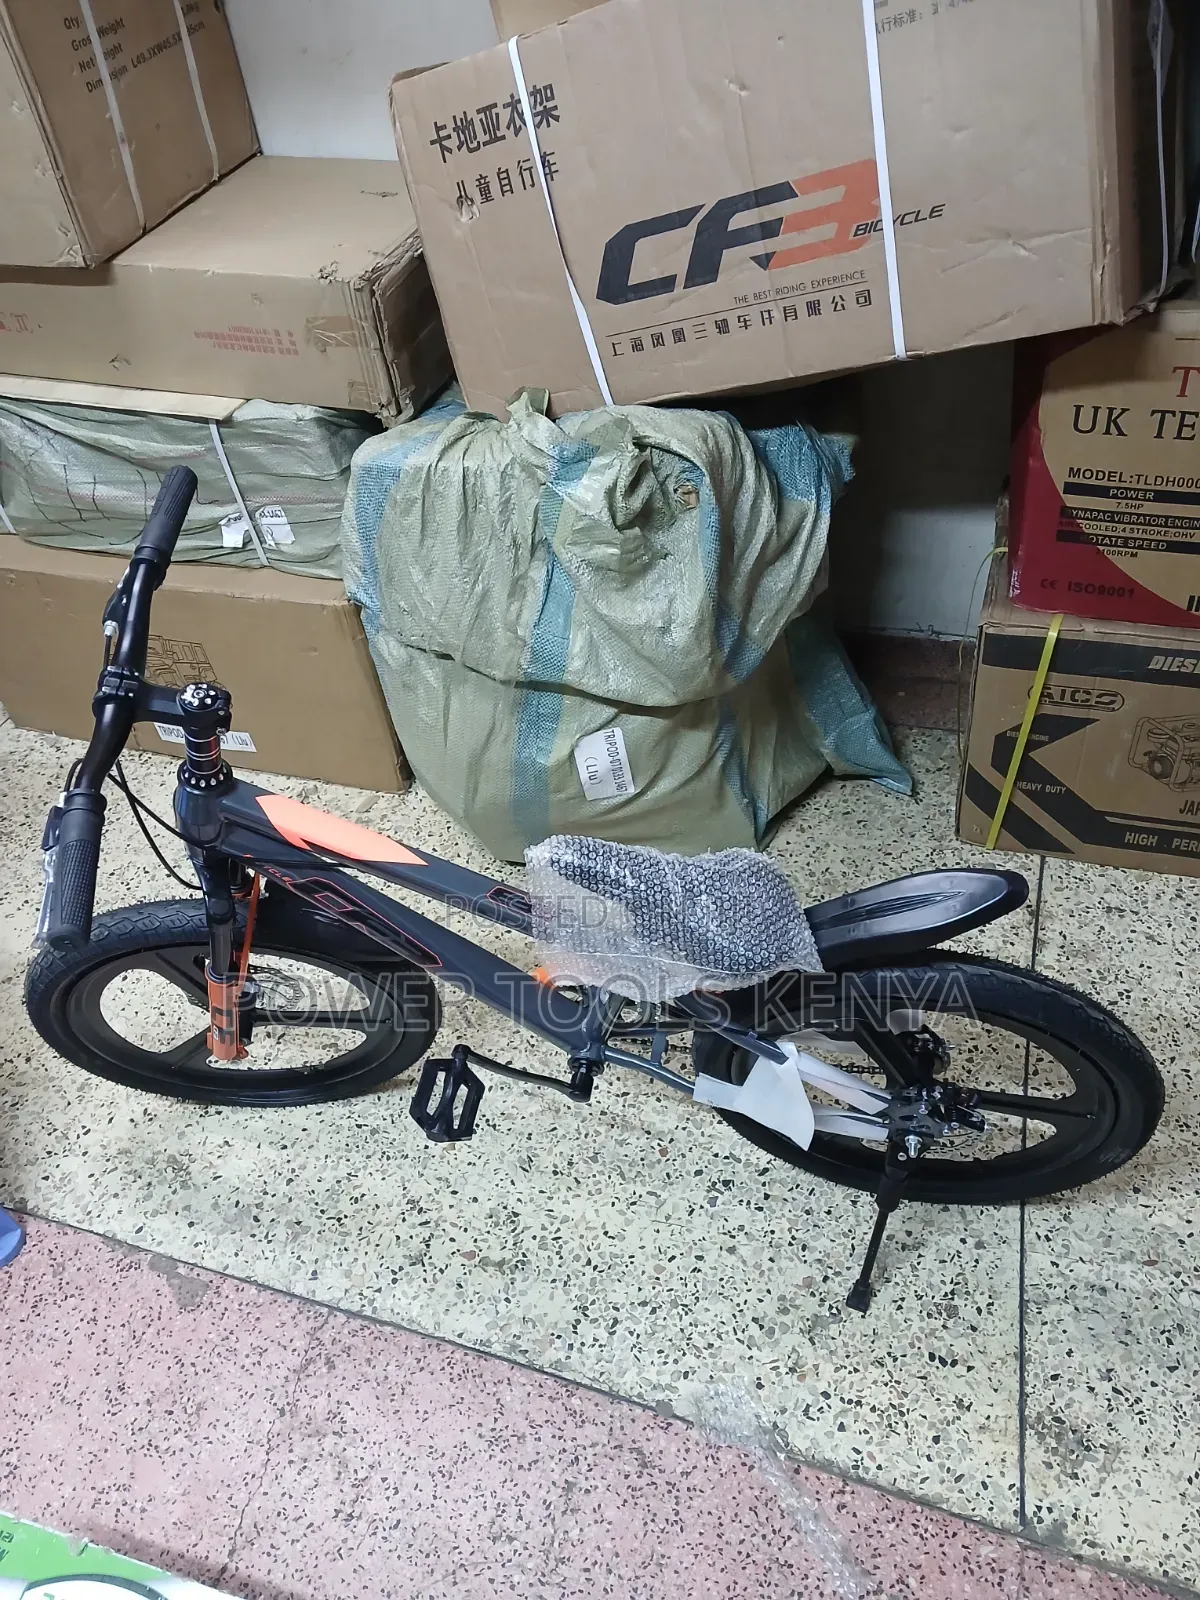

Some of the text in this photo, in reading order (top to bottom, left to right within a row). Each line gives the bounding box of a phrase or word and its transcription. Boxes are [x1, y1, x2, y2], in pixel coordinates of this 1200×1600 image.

[71, 35, 92, 51] Gros
[78, 42, 123, 73] Net eight
[429, 83, 560, 163] 卡地亚衣架
[456, 151, 559, 206] 儿童自行车
[734, 269, 866, 305] THE BEST RIDING EXPERIENCE
[1072, 404, 1199, 440] UK TE
[1109, 488, 1154, 500] POWER
[1115, 501, 1144, 510] 7.5HP
[1069, 509, 1112, 521] YNAPAC
[1114, 512, 1165, 526] VIBRATOR
[1087, 536, 1167, 550] OTATE SPEED
[1067, 581, 1135, 599] ISO9001
[1016, 781, 1067, 795] HEAVY DUTY
[1124, 832, 1158, 847] HIGH
